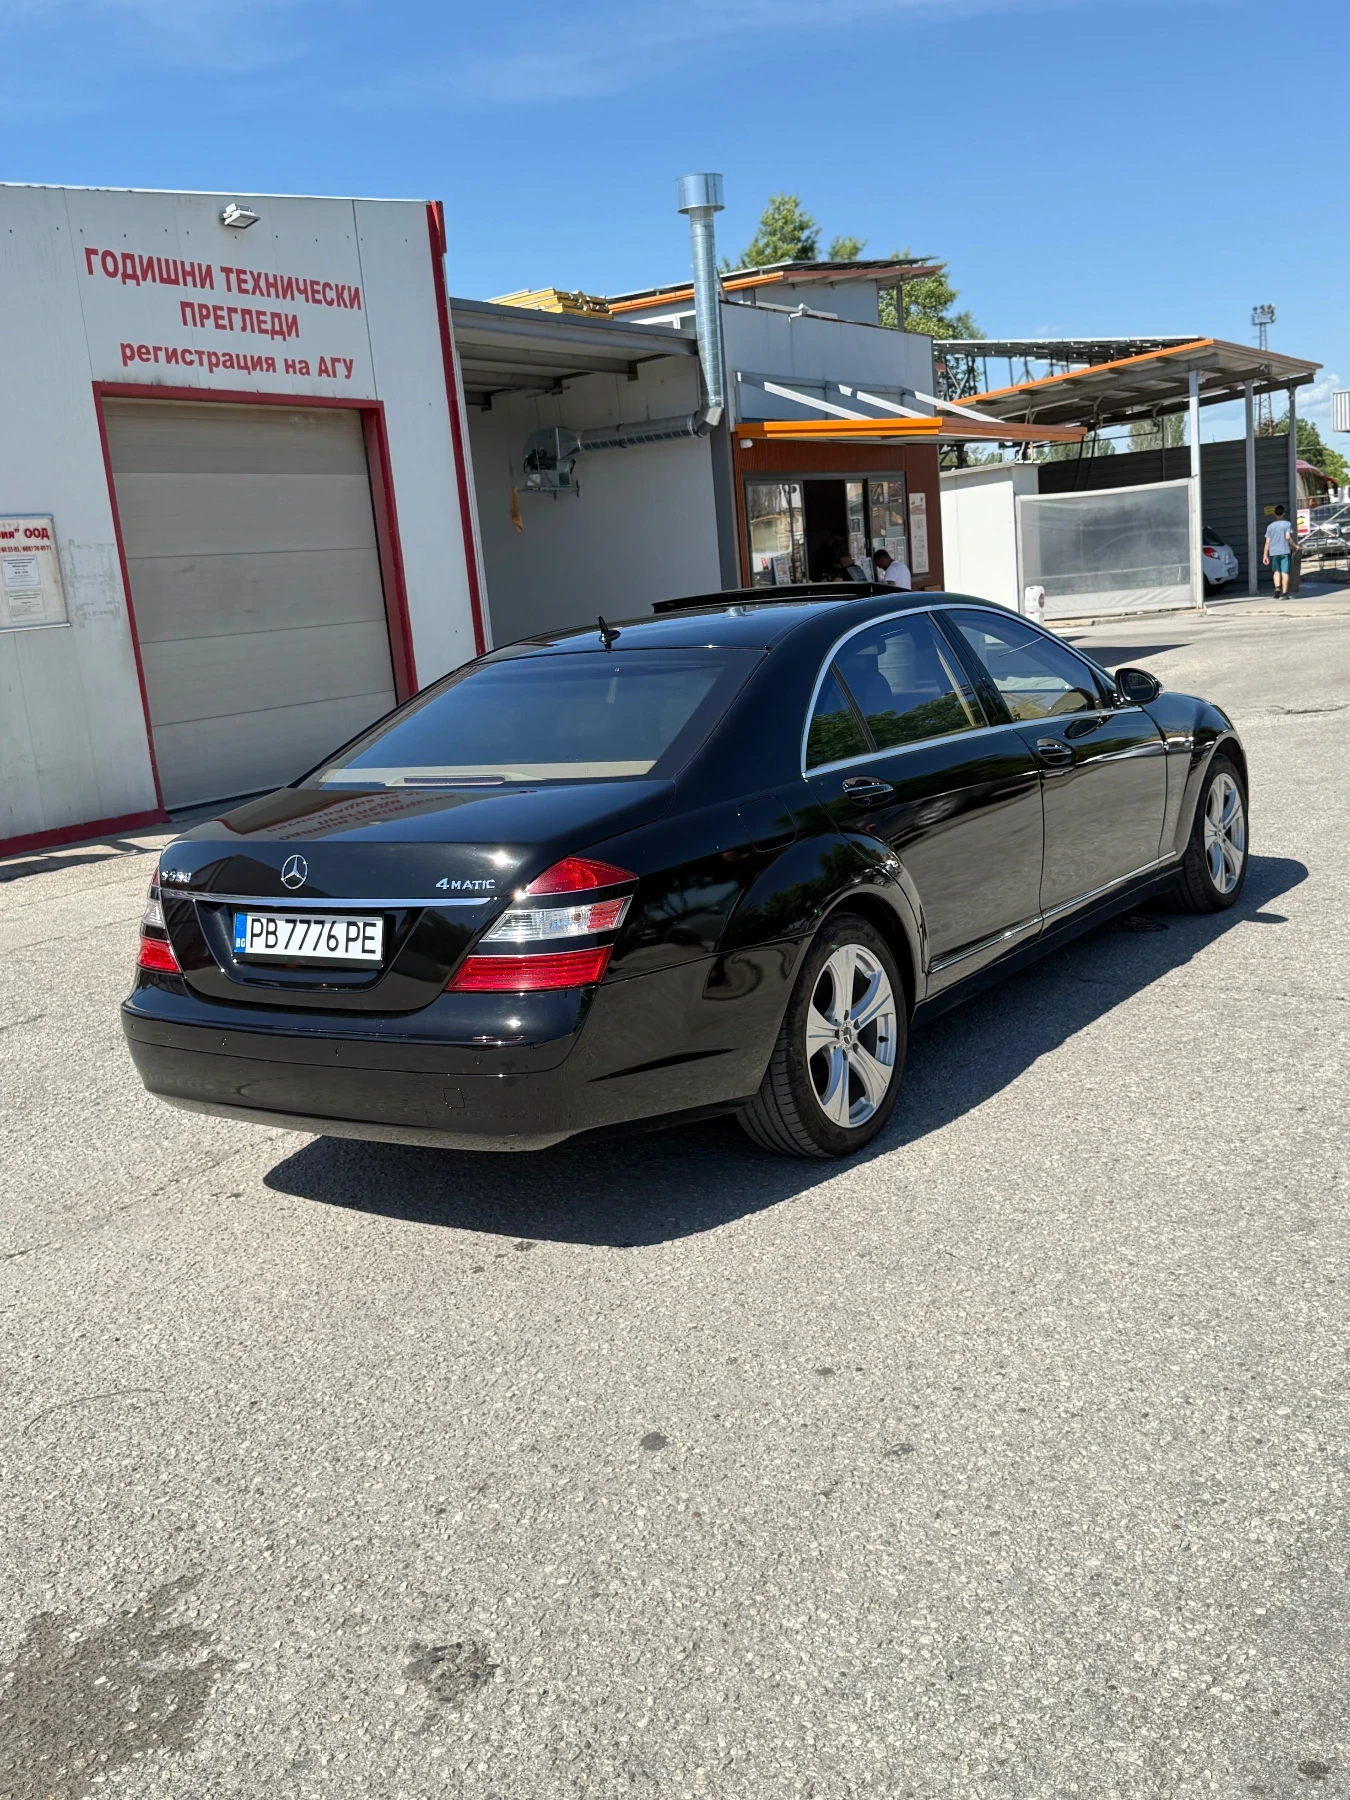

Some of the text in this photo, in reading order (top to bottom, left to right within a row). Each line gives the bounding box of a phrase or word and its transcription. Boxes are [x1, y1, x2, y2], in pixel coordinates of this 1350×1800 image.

[85, 247, 362, 311] ГОДИШНИ ТЕХНИЧЕСКИ
[180, 301, 300, 341] ПРЕГЛЕДИ
[120, 342, 354, 379] регистрация на АГУ
[0, 528, 50, 540] ия" ООД
[435, 877, 496, 890] 4MATIC
[235, 918, 377, 954] BG PB 7776 PE
